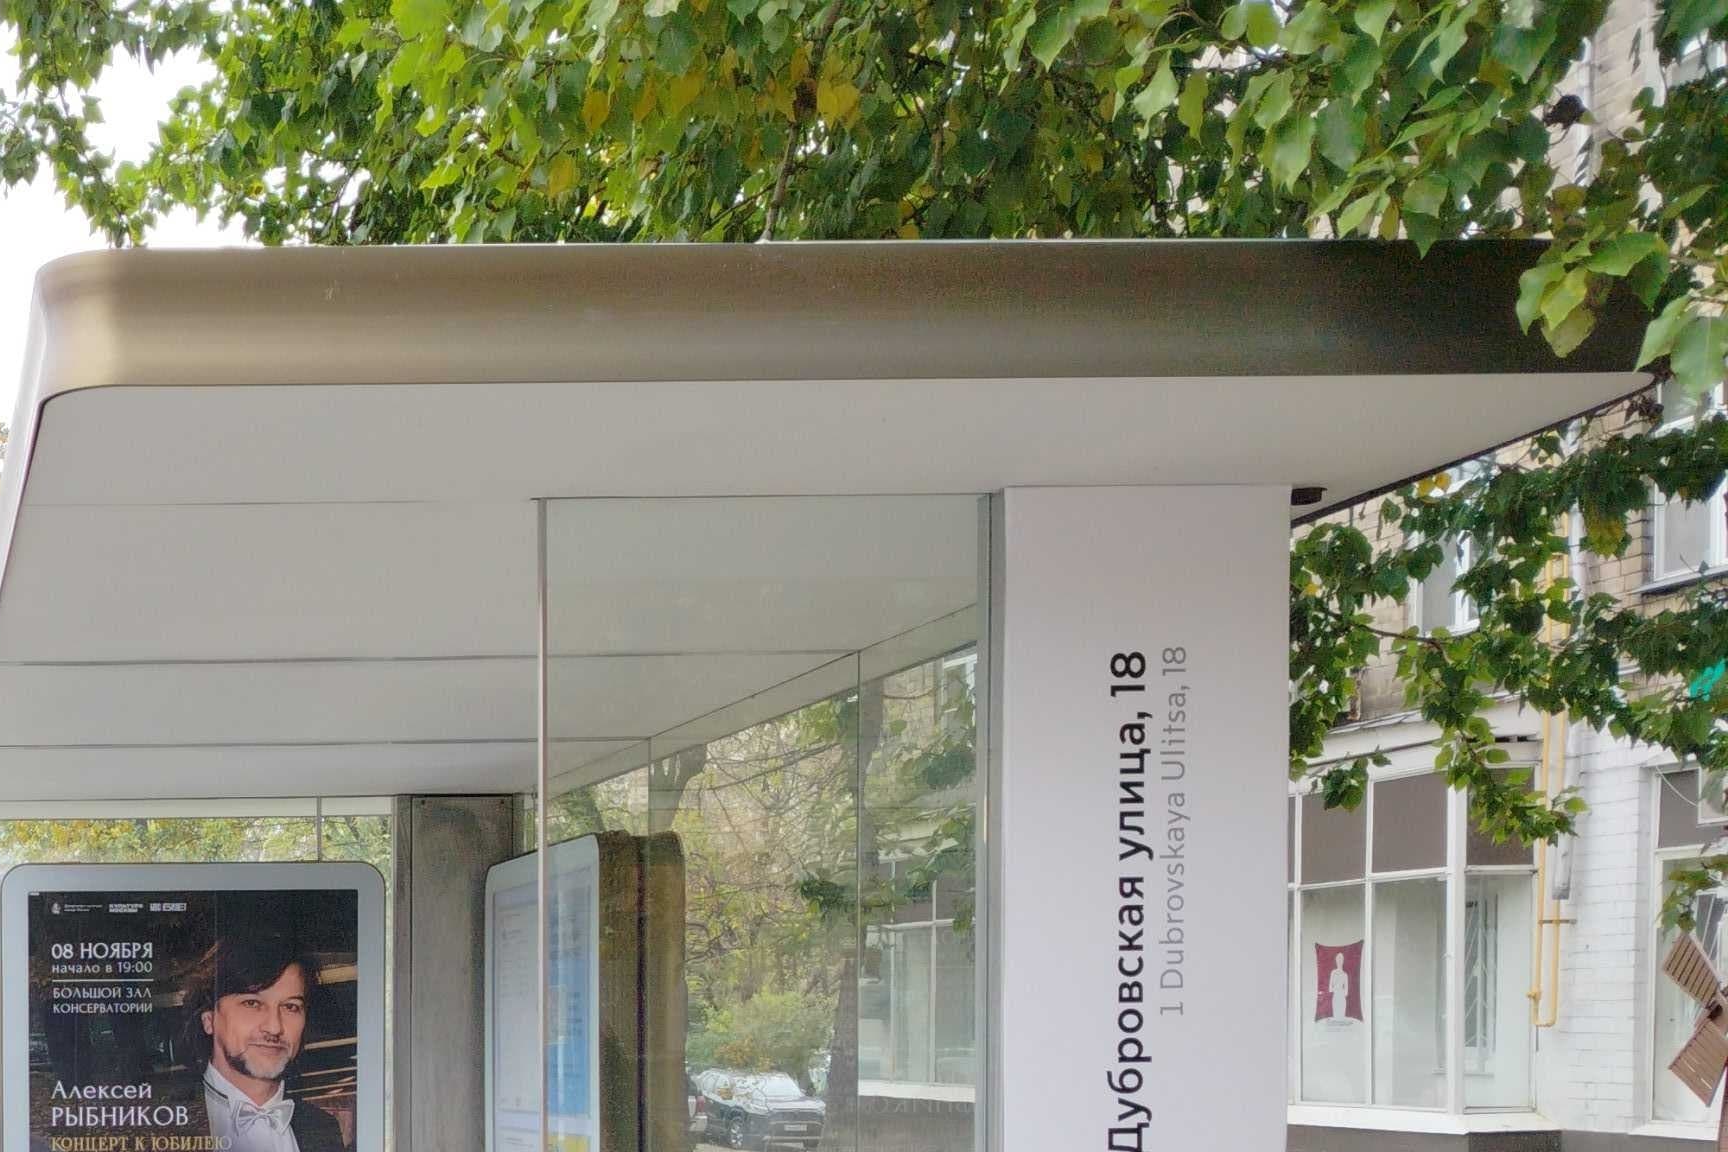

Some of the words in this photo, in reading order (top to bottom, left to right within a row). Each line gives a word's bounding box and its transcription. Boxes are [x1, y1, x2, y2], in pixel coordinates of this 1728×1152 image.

[1162, 647, 1186, 676] 18
[1110, 651, 1146, 698] 18
[1159, 685, 1190, 780] Ulitsa,
[1119, 711, 1153, 861] улица,
[1158, 792, 1191, 989] Dubrovskaya
[51, 943, 73, 959] 08
[81, 942, 153, 959] НОЯБРЯ
[52, 964, 100, 974] начало
[118, 961, 152, 973] 19:00
[53, 985, 122, 999] БОЛЬШОЙ
[126, 987, 152, 998] ЗАЛ
[53, 1002, 152, 1014] КОНСЕРВАТОРИИ
[1160, 1002, 1184, 1015] 1
[51, 1080, 152, 1099] Алексей
[51, 1105, 188, 1127] РЫБНИКОВ
[51, 1136, 129, 1152] КОНЦЕРТ
[135, 1136, 147, 1150] К
[152, 1135, 232, 1150] ЮБИЛЕЮ
